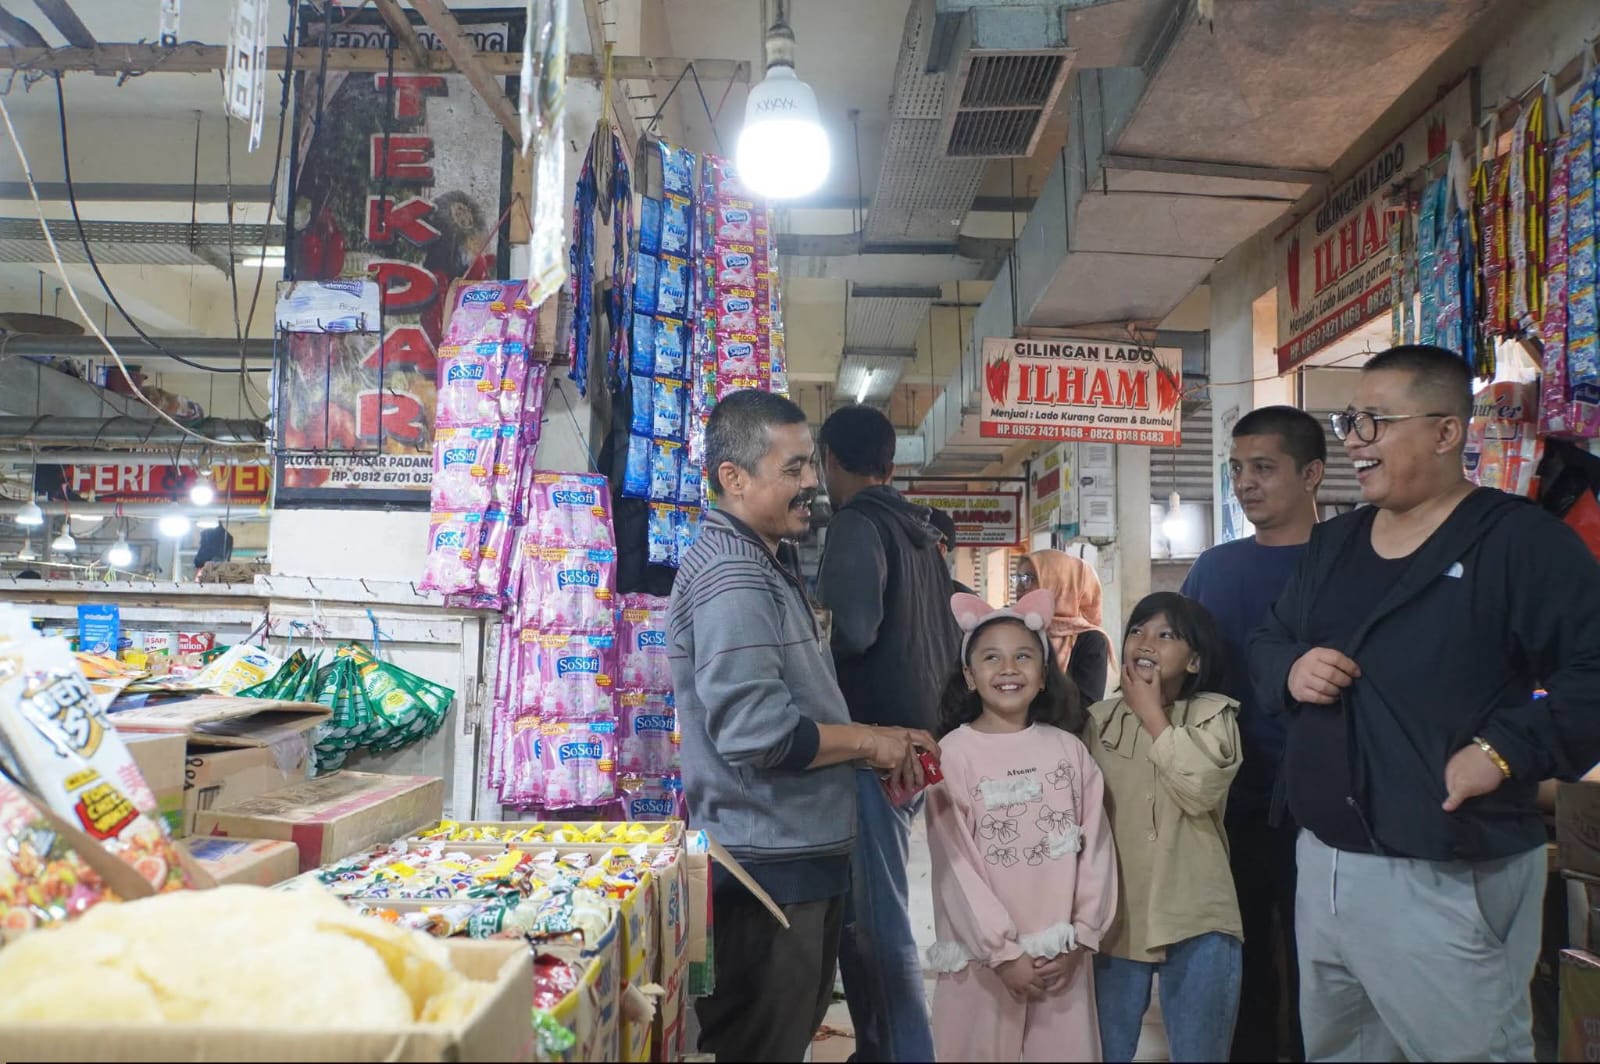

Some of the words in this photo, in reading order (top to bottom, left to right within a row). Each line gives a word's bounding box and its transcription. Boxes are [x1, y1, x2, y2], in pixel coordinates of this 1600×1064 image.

[1015, 343, 1099, 360] GILINGAN
[1105, 347, 1154, 362] LADO
[450, 364, 483, 379] SoSoft
[1017, 364, 1149, 409] ILHAM
[991, 408, 1028, 419] Menjual
[1036, 411, 1058, 419] Lado
[1061, 412, 1095, 423] Kurang
[1098, 414, 1128, 424] Garam
[1130, 416, 1137, 424] &
[1140, 416, 1172, 426] Bumbu
[1012, 425, 1037, 436] 0852
[1039, 426, 1058, 437] 7421
[1061, 427, 1083, 438] 1468
[1090, 429, 1114, 440] 0823
[351, 458, 388, 467] PASAR
[73, 464, 150, 491] FERI
[332, 472, 350, 482] HP.
[353, 473, 381, 482] 0812
[384, 473, 410, 483] 6701
[556, 491, 594, 505] SoSoft
[560, 572, 598, 584] SoSoft
[560, 658, 598, 671] SoSoft
[638, 717, 674, 730] SoSoft
[561, 743, 600, 758] SoSoft
[634, 802, 671, 814] SoSoft
